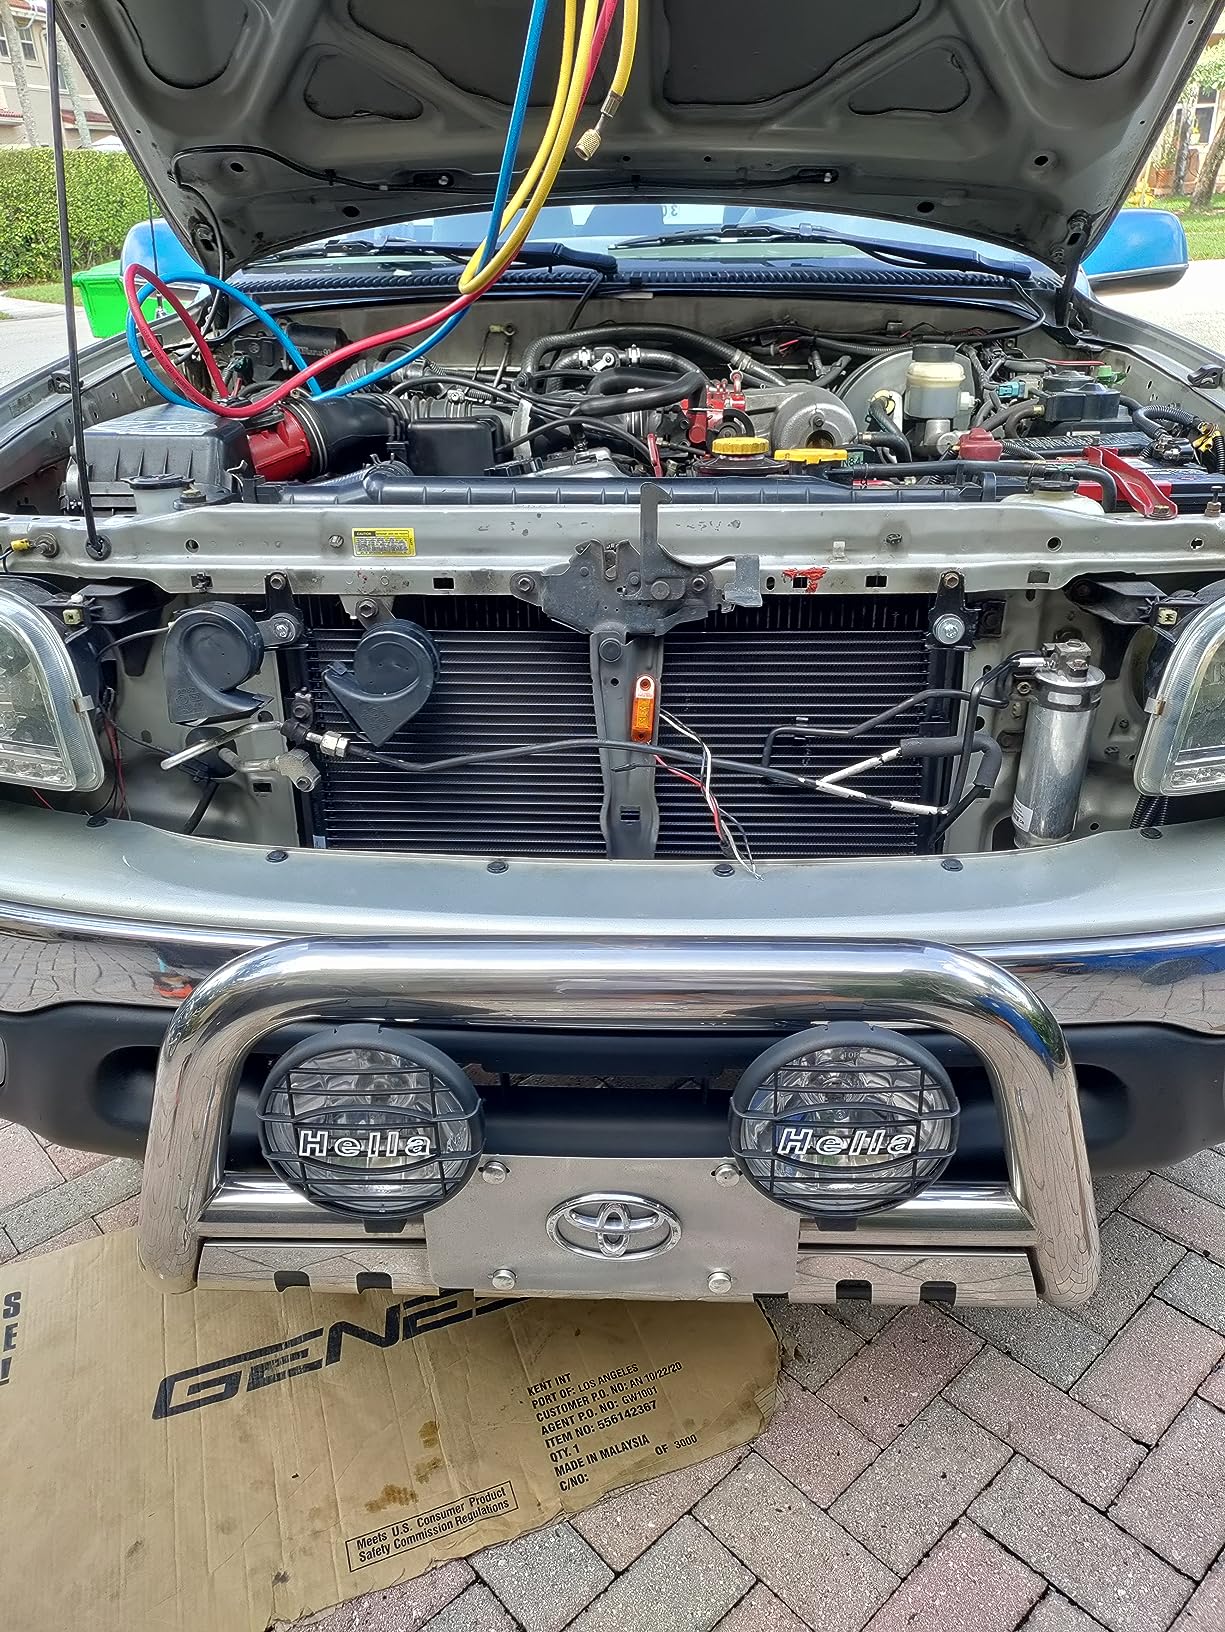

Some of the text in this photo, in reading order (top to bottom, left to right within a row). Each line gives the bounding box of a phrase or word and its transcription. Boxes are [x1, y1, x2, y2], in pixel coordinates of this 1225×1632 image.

[299, 1130, 431, 1157] Hella
[777, 1128, 915, 1155] Hella
[527, 1373, 571, 1396] KENT INT
[532, 1364, 639, 1409] PORT OF: LOS ANGELES
[536, 1361, 683, 1423] CUSTOMER P.O. NO: AN 10/22/20
[541, 1386, 658, 1435] AGENT P.O. NO: GW1001
[544, 1431, 574, 1449] ITEM
[576, 1424, 595, 1437] NO:
[549, 1444, 581, 1463] QTY. 1
[554, 1434, 650, 1477] MADE IN MALAYSIA
[559, 1434, 698, 1492] C/NO: OF 3000
[356, 1487, 506, 1551] Meets U.S. Consumer Product
[359, 1499, 510, 1563] Safety Commission Regulations
